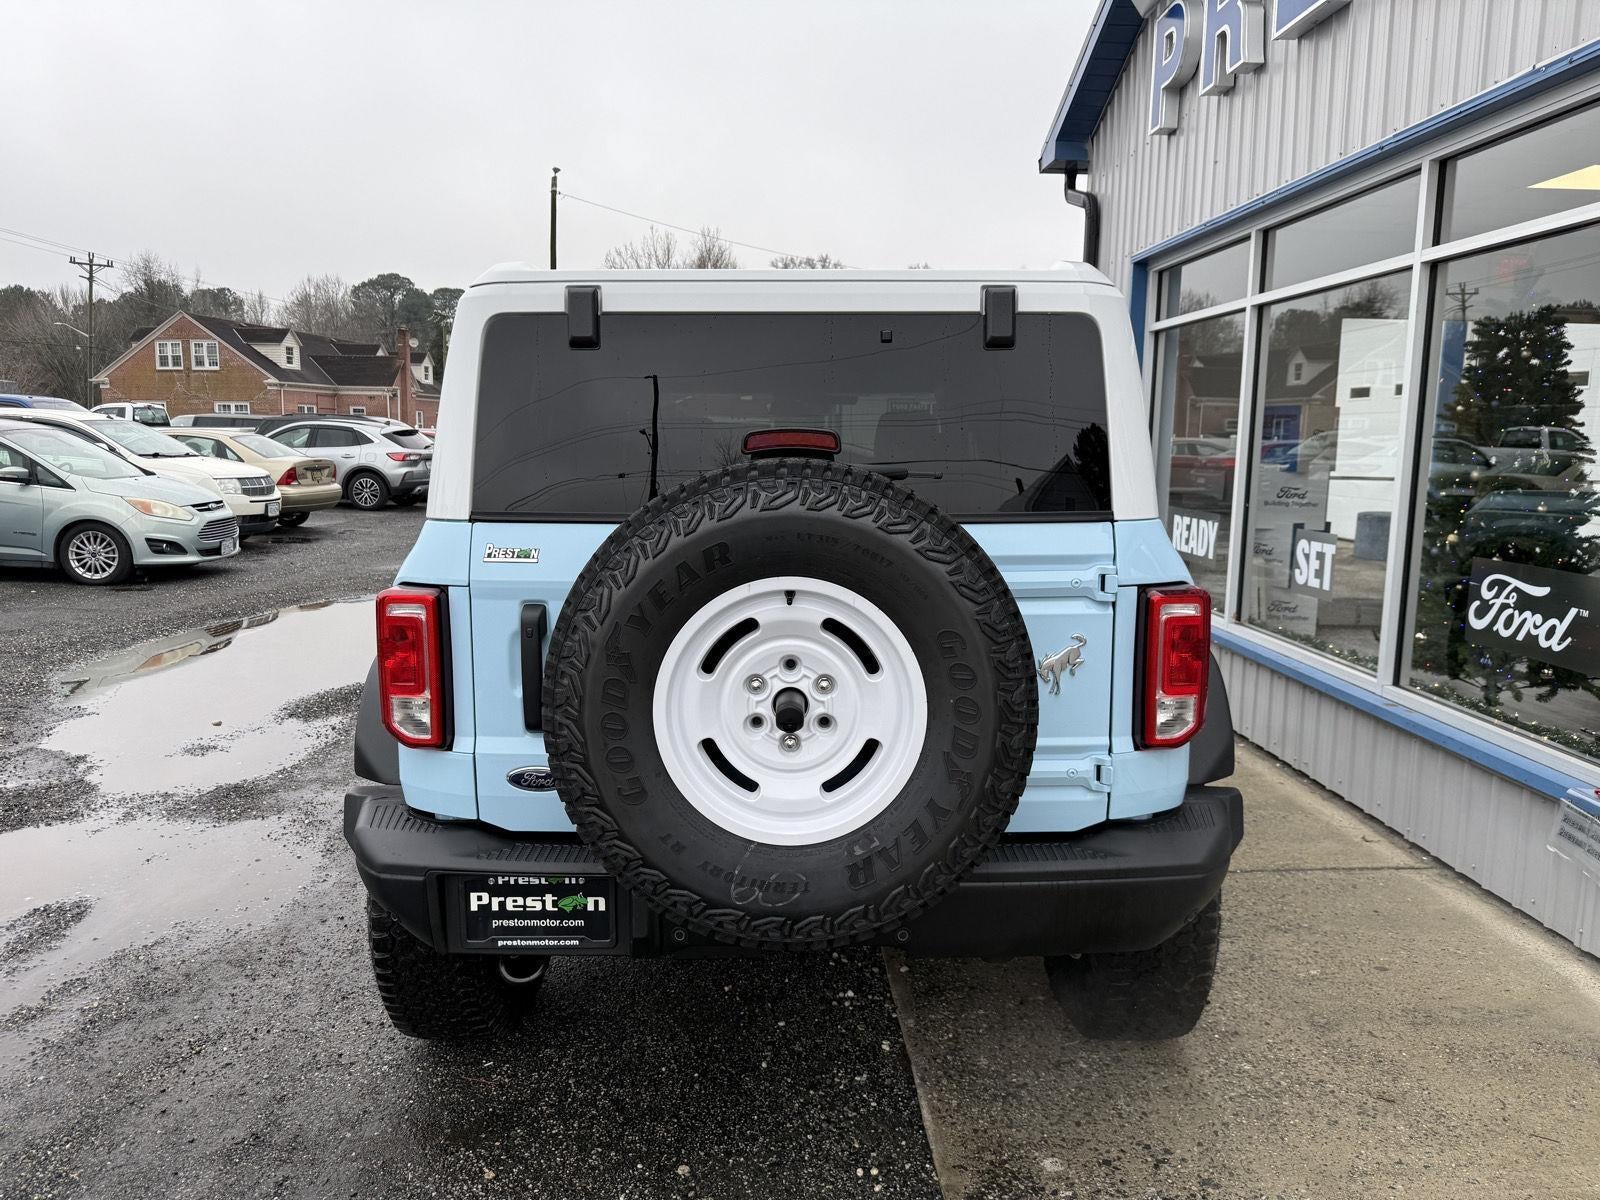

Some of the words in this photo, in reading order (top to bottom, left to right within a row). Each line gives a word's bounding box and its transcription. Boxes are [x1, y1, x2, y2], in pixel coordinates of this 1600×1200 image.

[1148, 0, 1350, 136] PR
[1276, 486, 1309, 500] Ford
[1172, 514, 1219, 560] READY
[1294, 538, 1337, 591] SET
[1468, 573, 1579, 652] Ford
[492, 918, 585, 929] prestonmotor.com
[497, 939, 580, 947] prestonmotor.com
